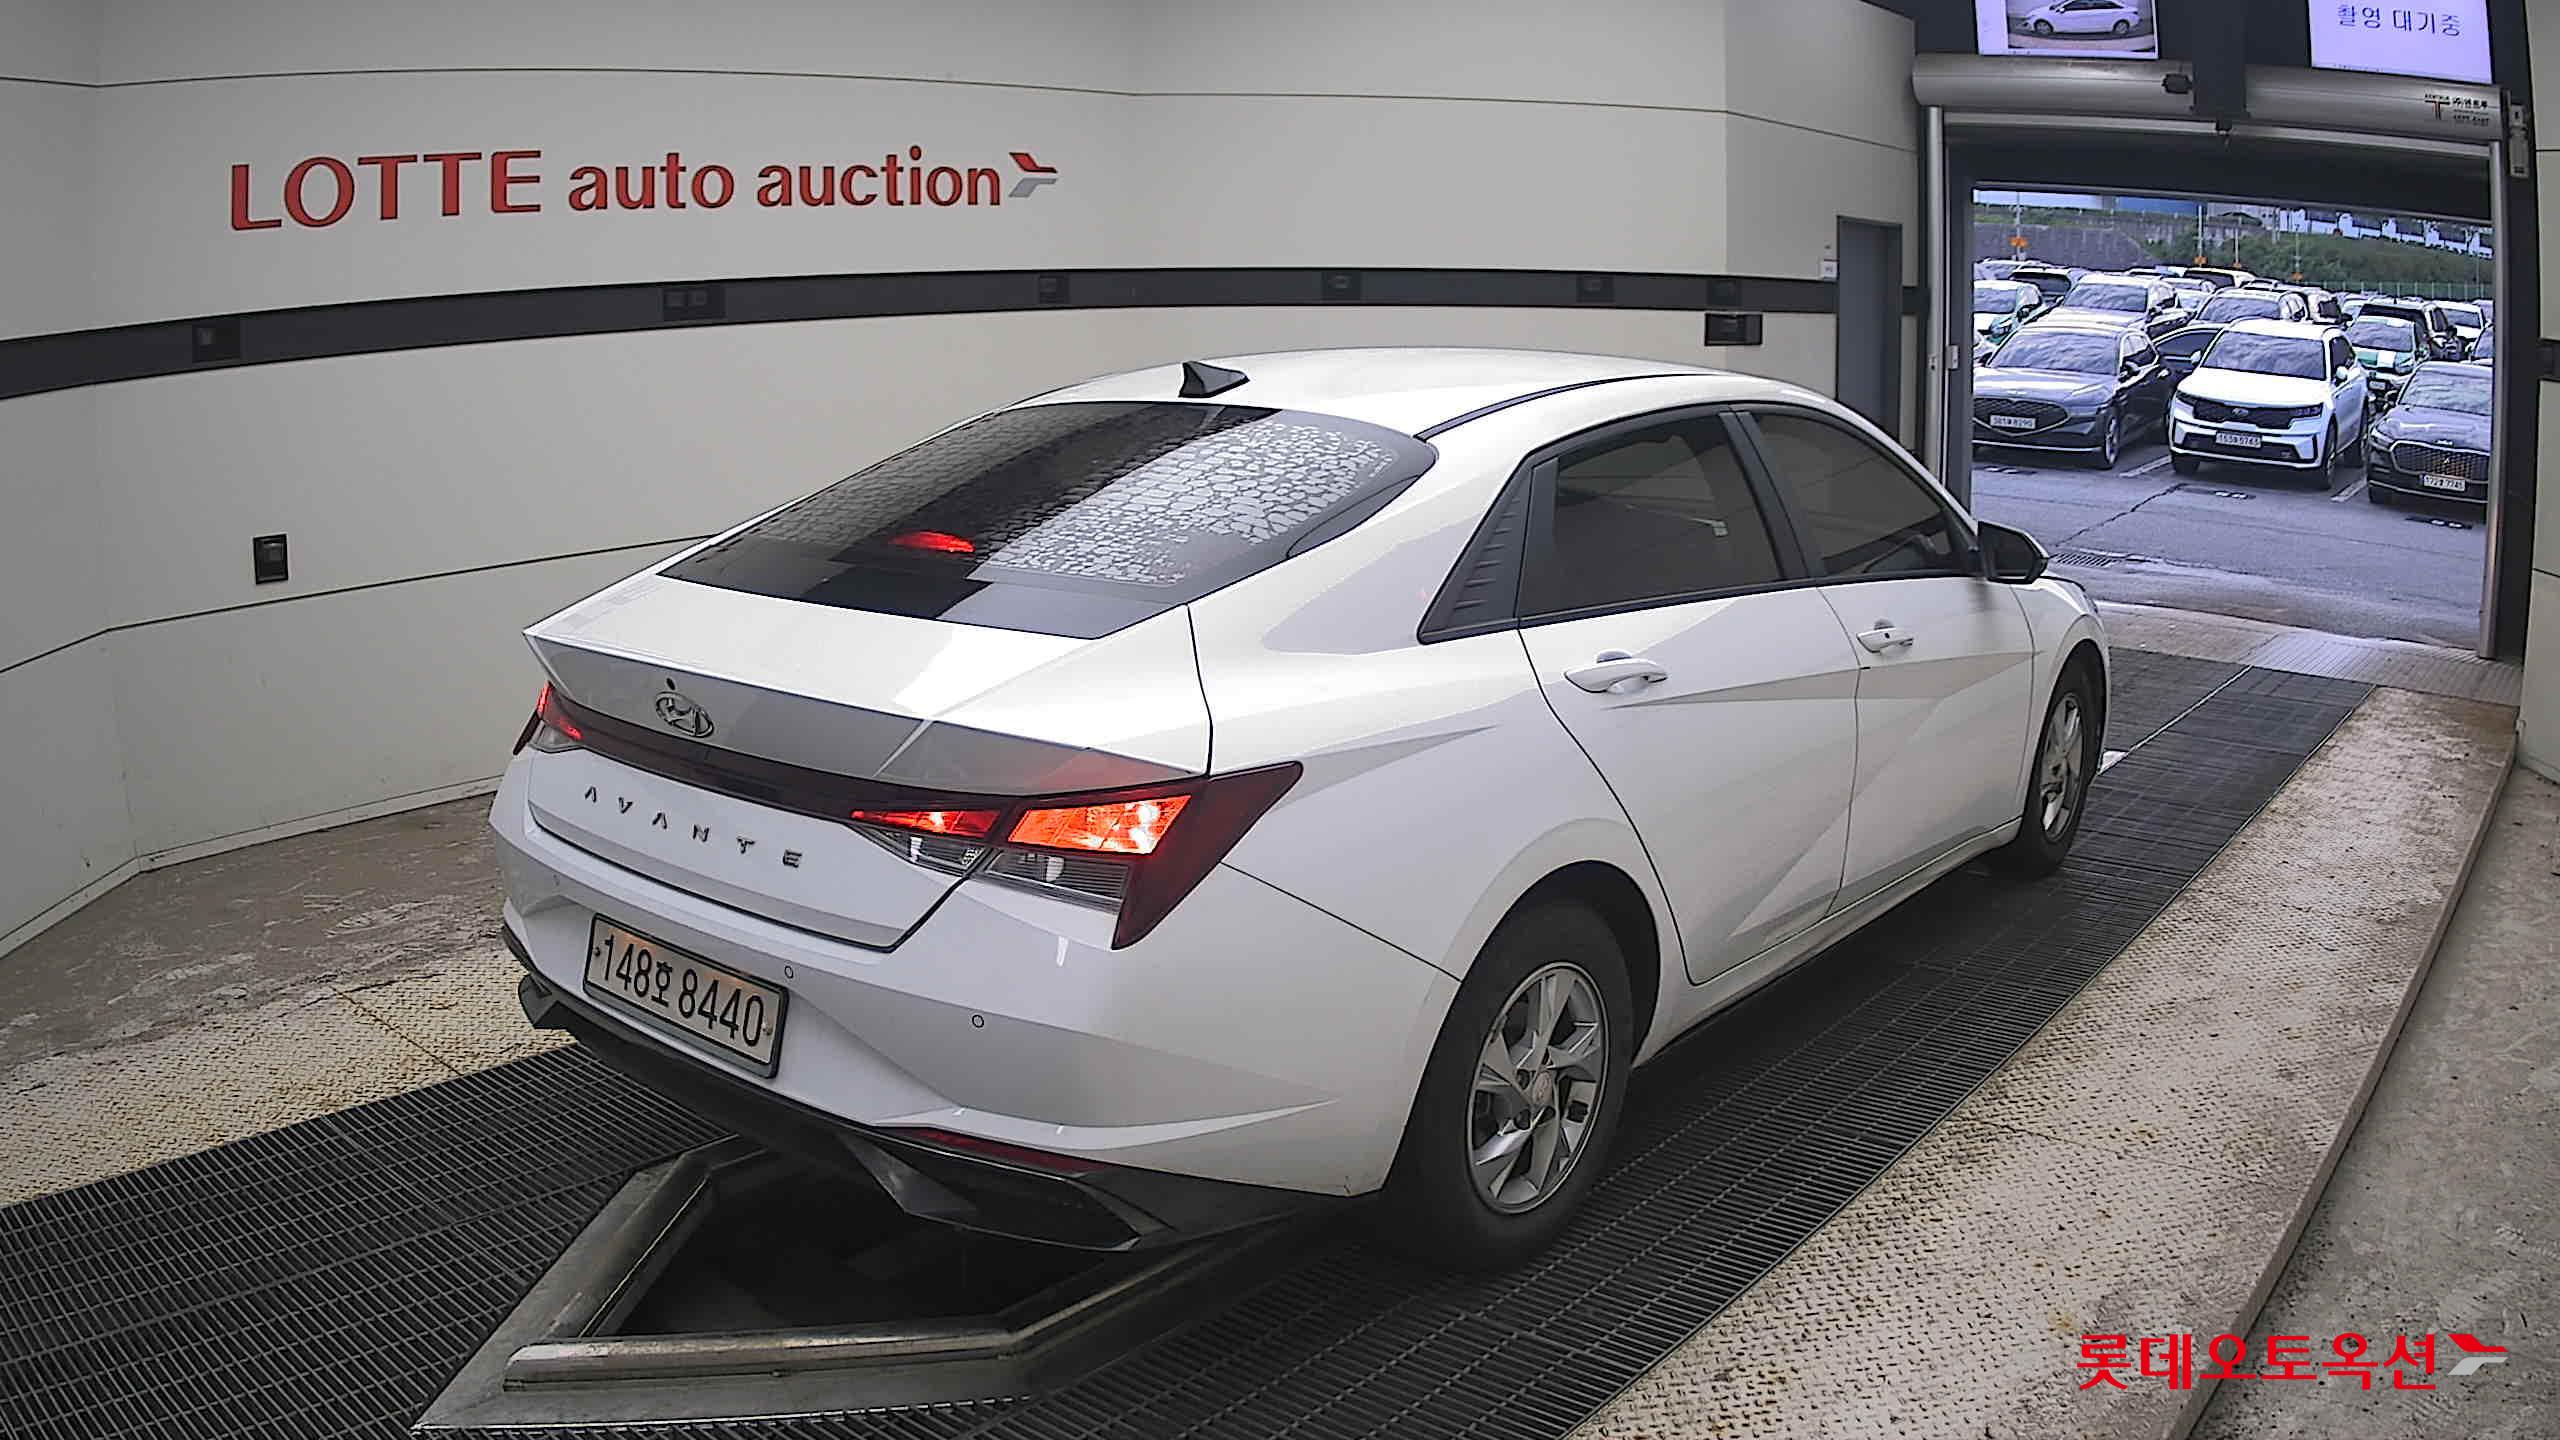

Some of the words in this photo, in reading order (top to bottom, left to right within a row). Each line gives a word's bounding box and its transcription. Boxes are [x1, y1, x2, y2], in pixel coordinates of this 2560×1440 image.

[2337, 4, 2382, 30] 촬영
[2392, 9, 2461, 37] 대기중
[229, 150, 541, 231] LOTTE
[567, 152, 735, 211] auto
[756, 146, 1002, 207] auction
[584, 785, 802, 868] AVANTE
[603, 933, 674, 1008] 148호
[677, 967, 765, 1048] 8440
